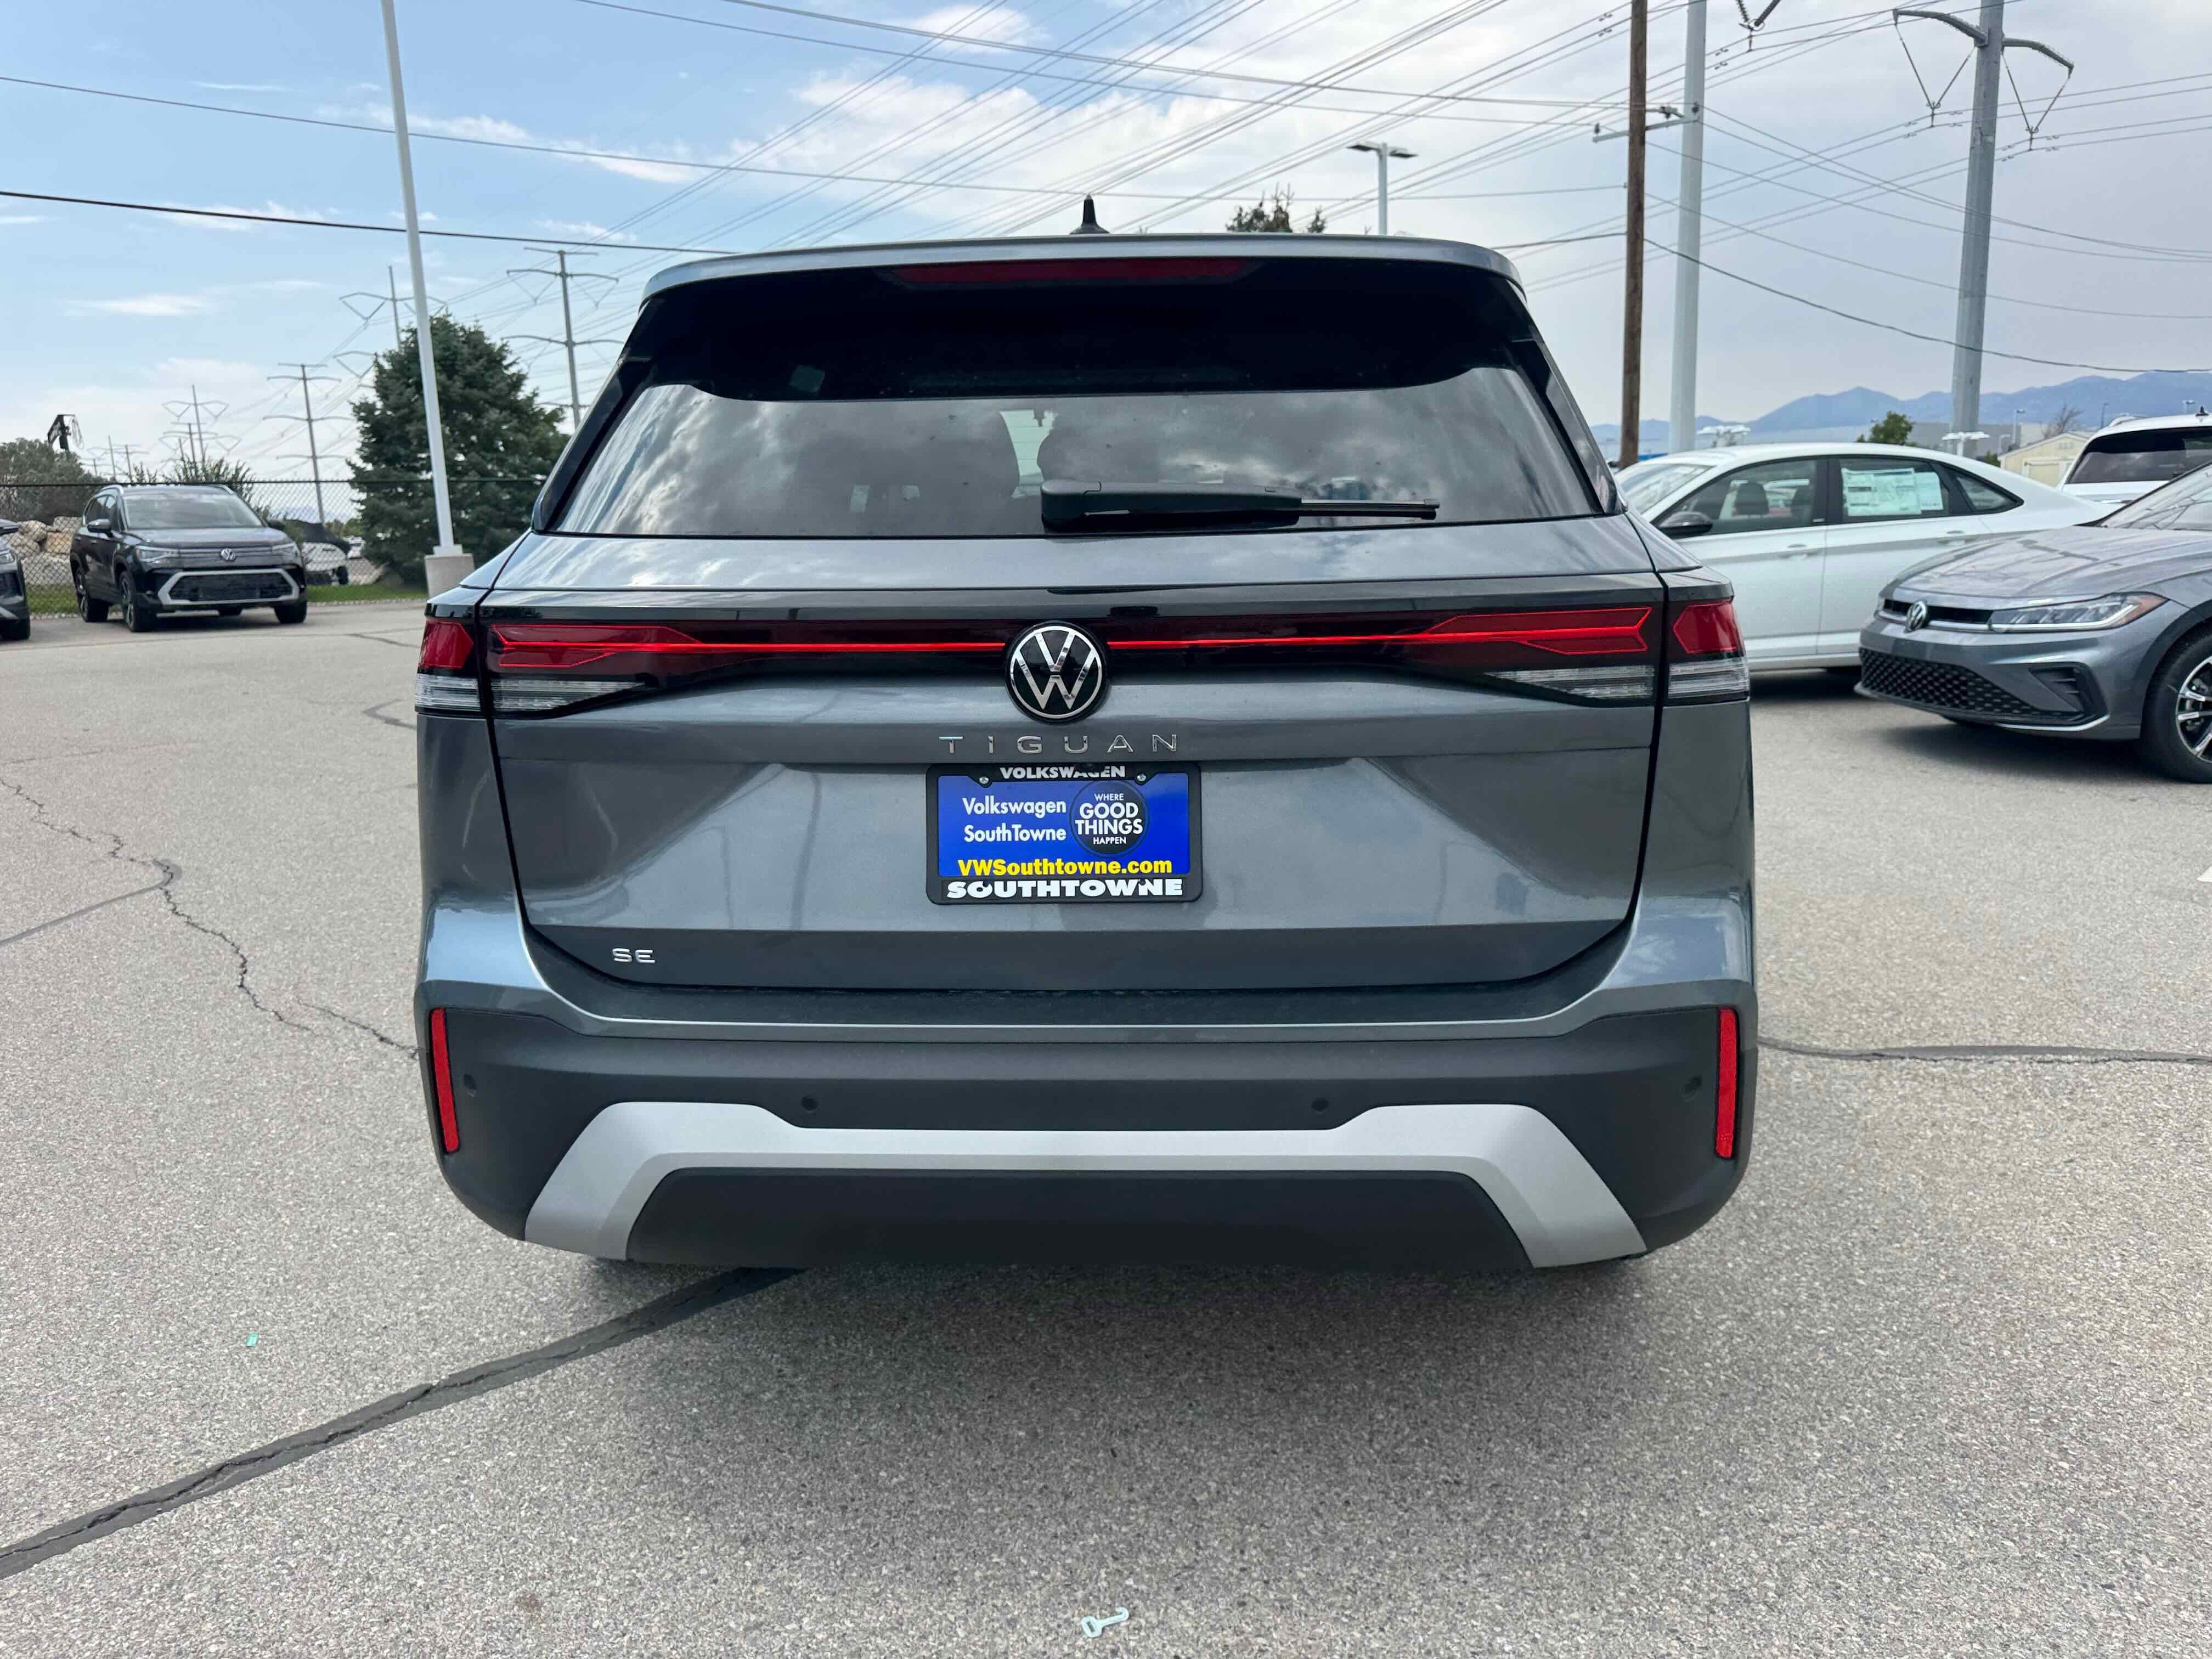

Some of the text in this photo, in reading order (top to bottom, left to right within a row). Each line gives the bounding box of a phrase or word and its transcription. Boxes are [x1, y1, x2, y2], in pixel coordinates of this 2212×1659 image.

[1012, 628, 1100, 715] VW
[939, 735, 1177, 754] TIGUAN
[962, 795, 1066, 818] Volkswagen
[1079, 803, 1138, 819] GOOD
[964, 822, 1066, 842] SouthTowne
[1075, 819, 1143, 835] THINGS
[958, 858, 1172, 876] VWSouthtowne.com
[947, 879, 1183, 899] SOUTHTOWNE
[612, 948, 656, 963] SE
